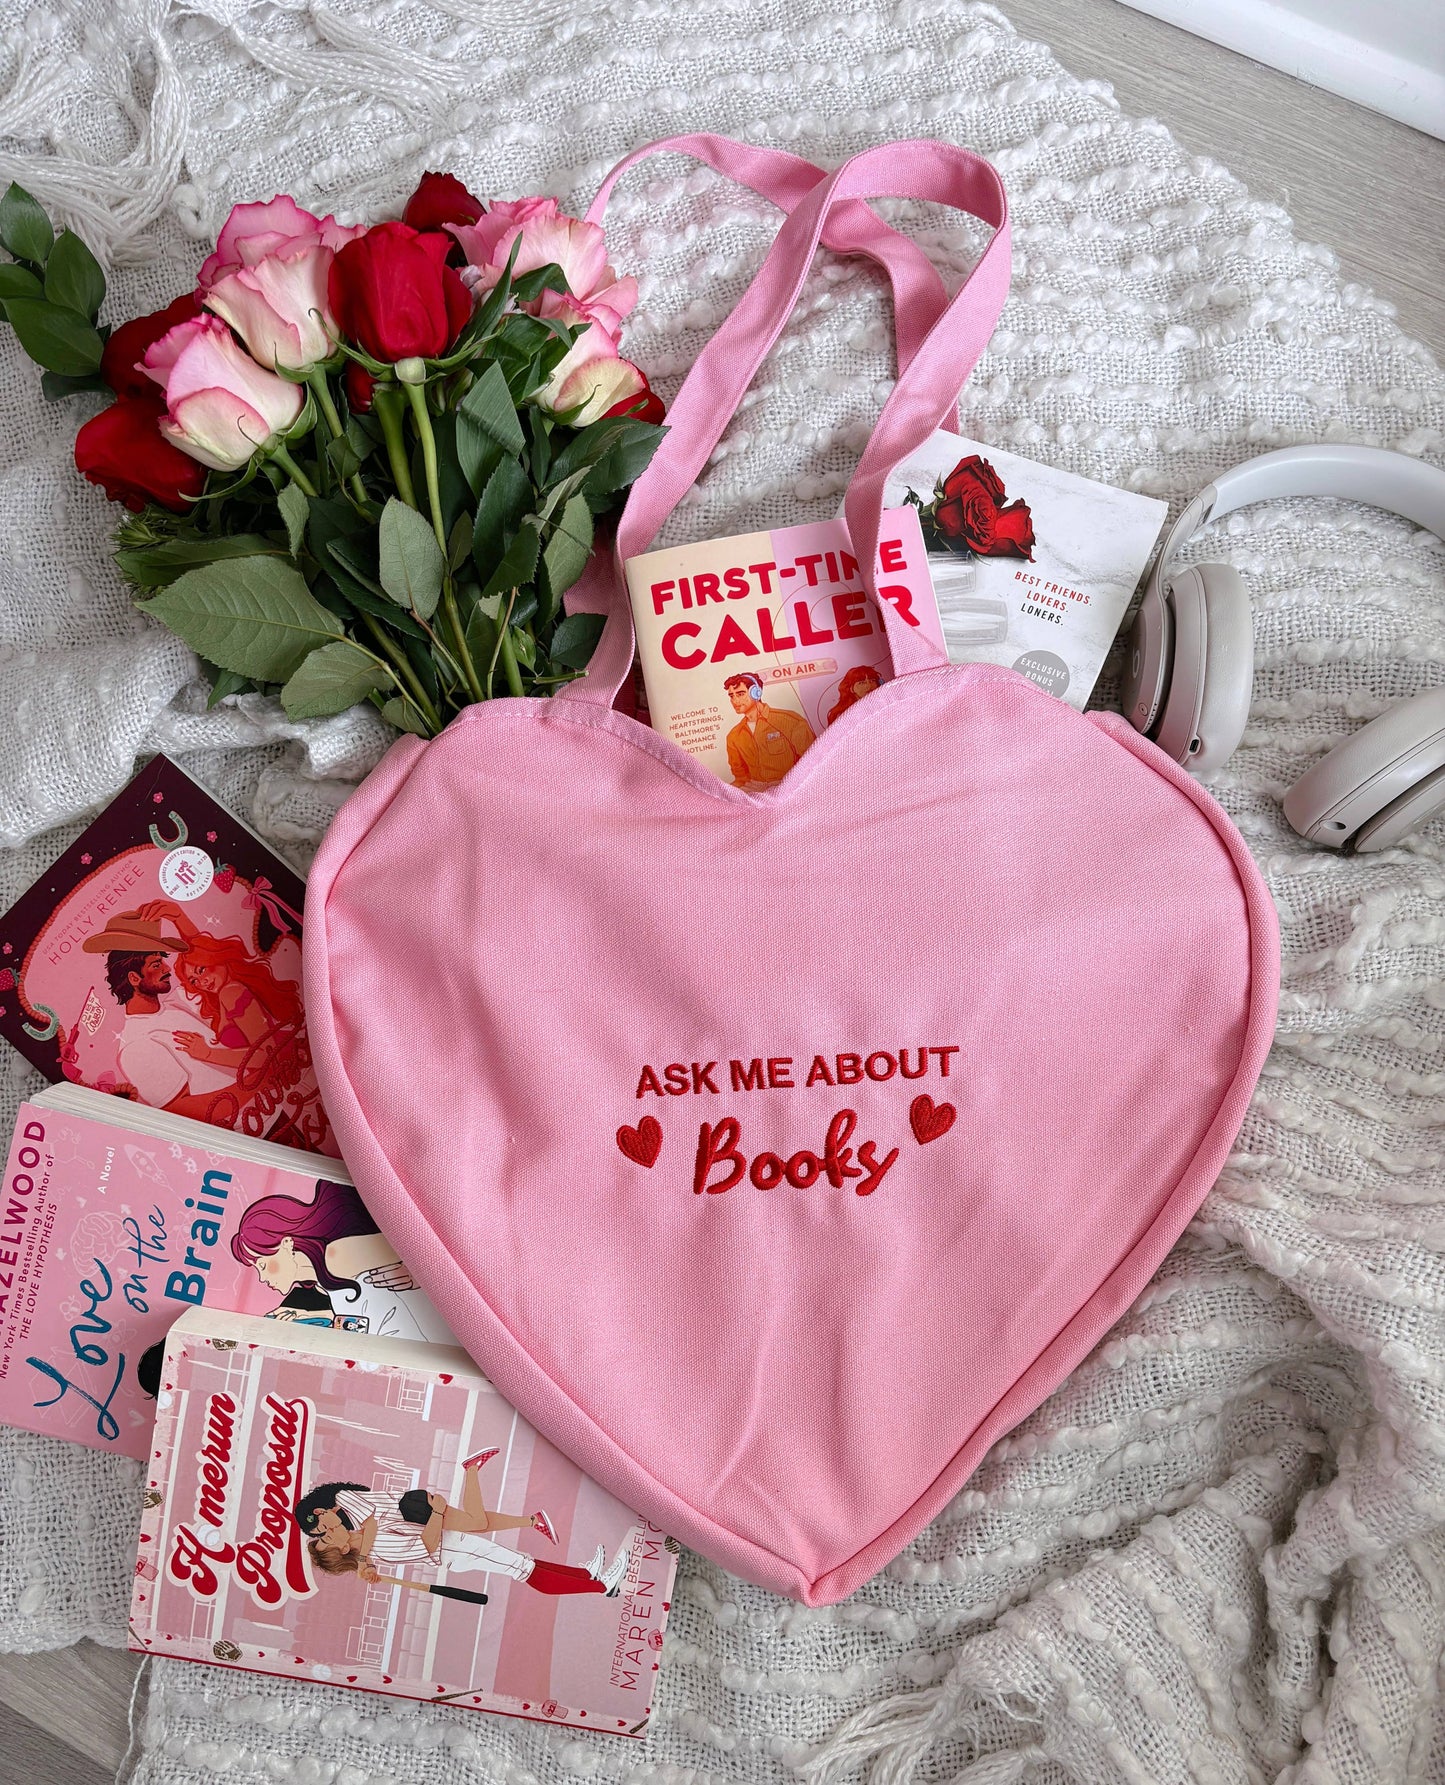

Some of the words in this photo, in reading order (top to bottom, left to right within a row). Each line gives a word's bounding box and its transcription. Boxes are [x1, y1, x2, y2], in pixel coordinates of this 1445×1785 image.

[1014, 571, 1041, 587] BEST
[1044, 581, 1092, 606] FRIENDS.
[1026, 590, 1069, 613] LOVERS.
[1020, 602, 1063, 626] LONERS.
[772, 667, 792, 678] ON
[796, 663, 816, 675] AIR
[1020, 657, 1067, 680] EXCLUSIVE
[1024, 670, 1054, 687] BONUS
[670, 709, 706, 721] WELCOME
[674, 724, 721, 739] BALTIMORE'S
[681, 734, 717, 746] ROMANCE
[48, 915, 95, 965] HOLLY
[96, 865, 145, 915] RENEE
[54, 922, 74, 941] TODAY
[73, 883, 111, 921] BESTSELLING
[110, 859, 133, 884] AUTHOR
[636, 1061, 720, 1099] ASK
[729, 1057, 795, 1092] ME
[806, 1046, 959, 1087] ABOUT
[45, 1153, 55, 1167] of
[100, 1146, 116, 1181] Novel
[693, 1108, 900, 1197] Books
[34, 1172, 51, 1213] Author
[97, 1186, 107, 1195] A
[18, 1218, 43, 1283] Bestselling
[122, 1204, 170, 1268] the
[163, 1169, 233, 1306] Brain
[19, 1317, 32, 1340] THE
[26, 1282, 40, 1314] LOVE
[33, 1203, 57, 1279] HYPOTHESIS
[10, 1287, 25, 1320] Times
[122, 1273, 149, 1313] on
[4, 1325, 17, 1350] York
[25, 1257, 126, 1441] Love
[0, 1354, 11, 1379] New
[236, 1395, 311, 1604] Proposal
[609, 1589, 636, 1686] INTERNATIONAL
[620, 1580, 656, 1690] MAREN
